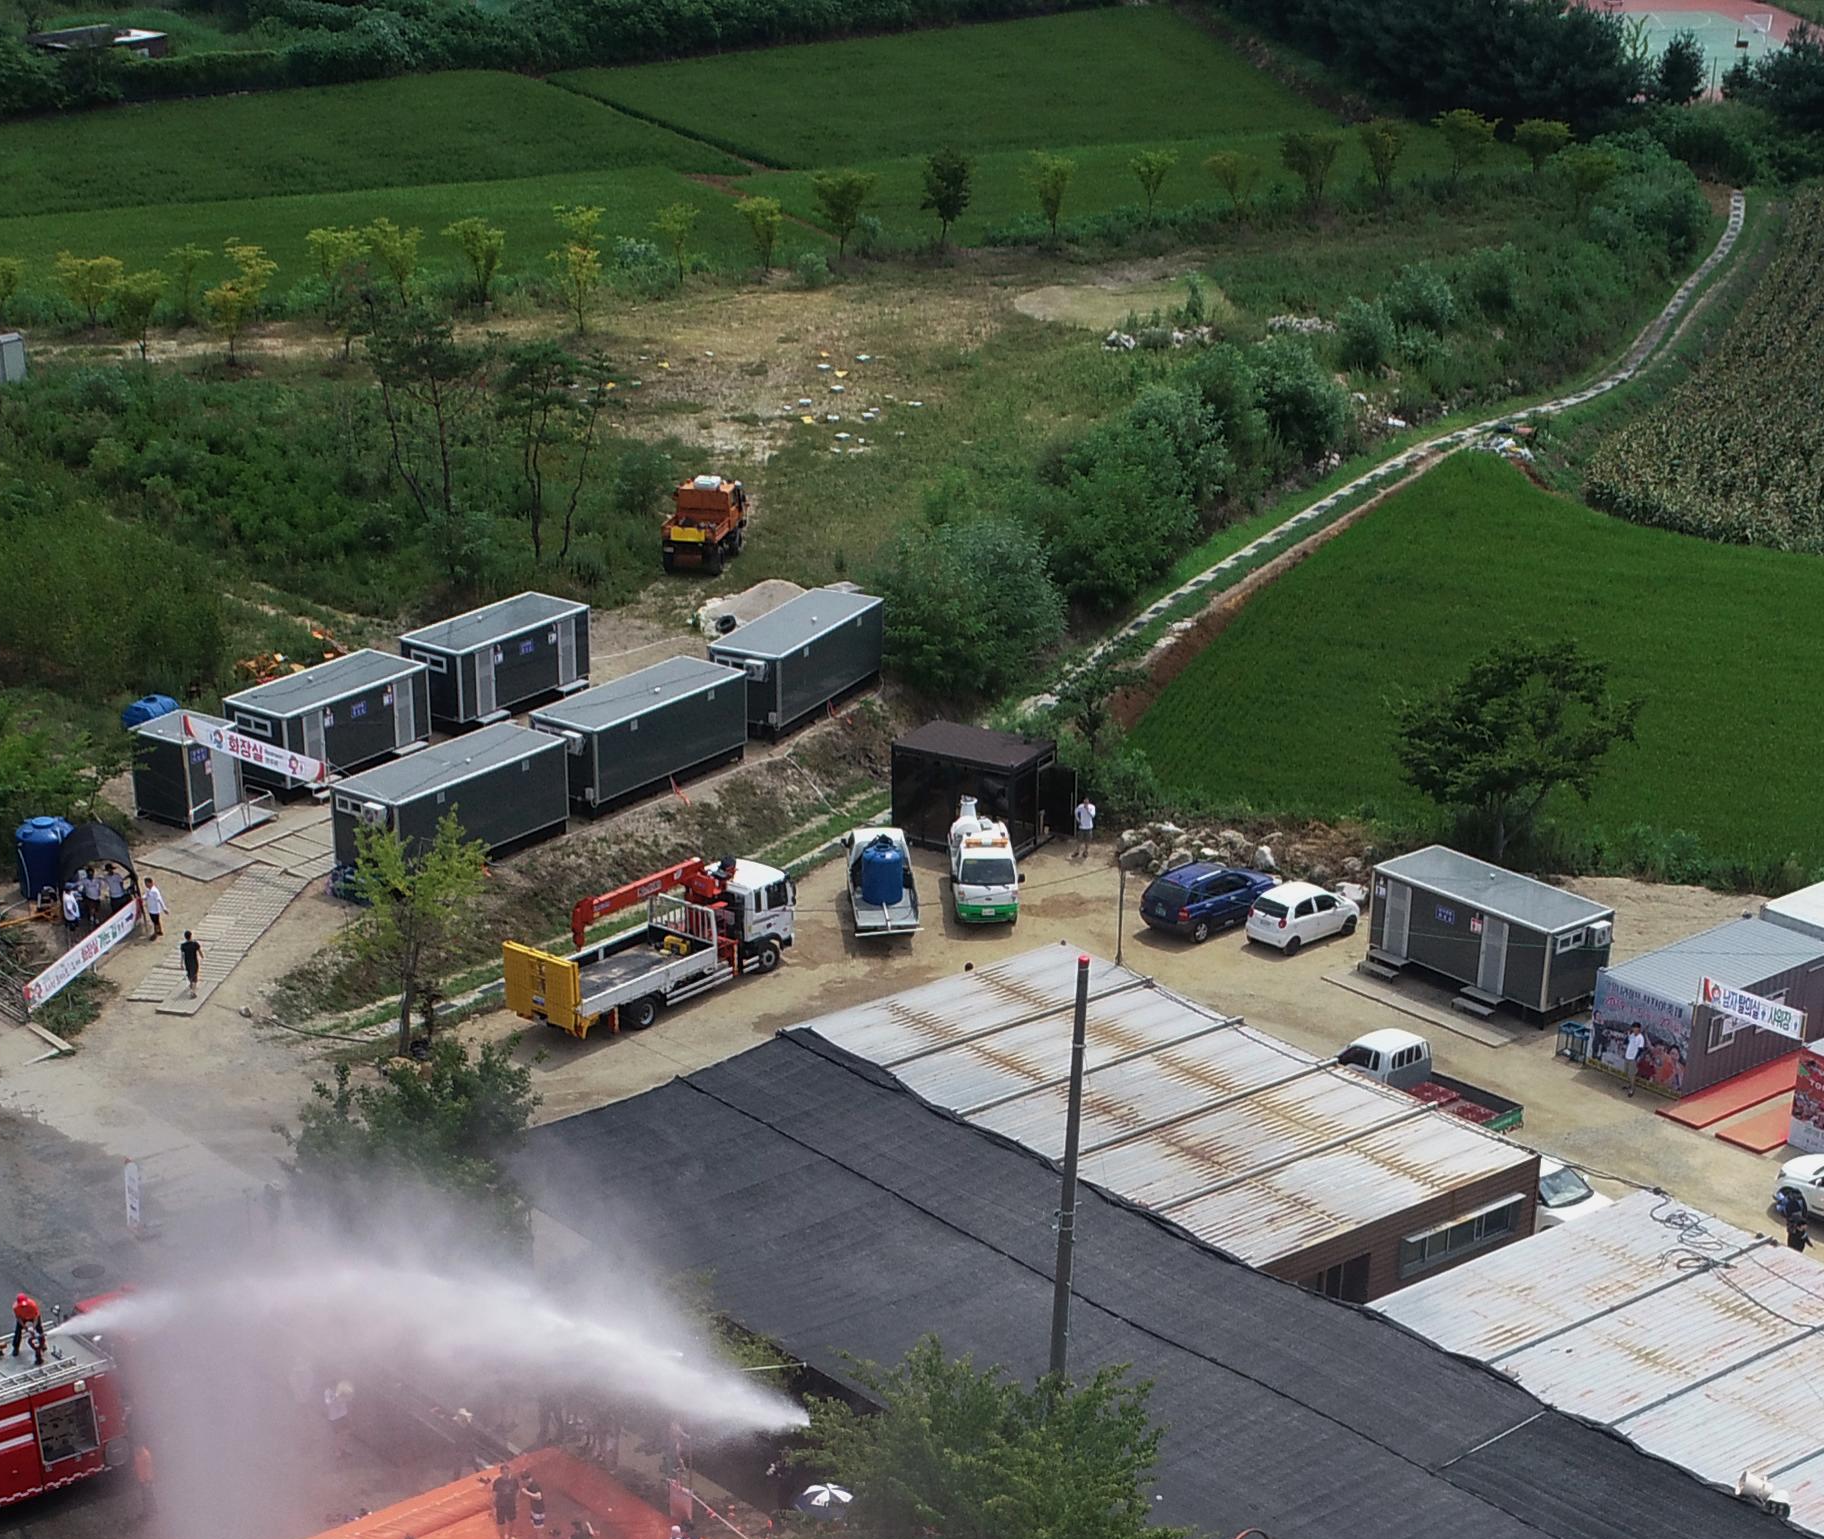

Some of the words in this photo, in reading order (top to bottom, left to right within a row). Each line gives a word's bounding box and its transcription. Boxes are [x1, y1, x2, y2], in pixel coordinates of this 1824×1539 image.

[228, 735, 263, 763] 화장실
[1722, 988, 1738, 1011] 남자
[1738, 995, 1761, 1020] 탈의실
